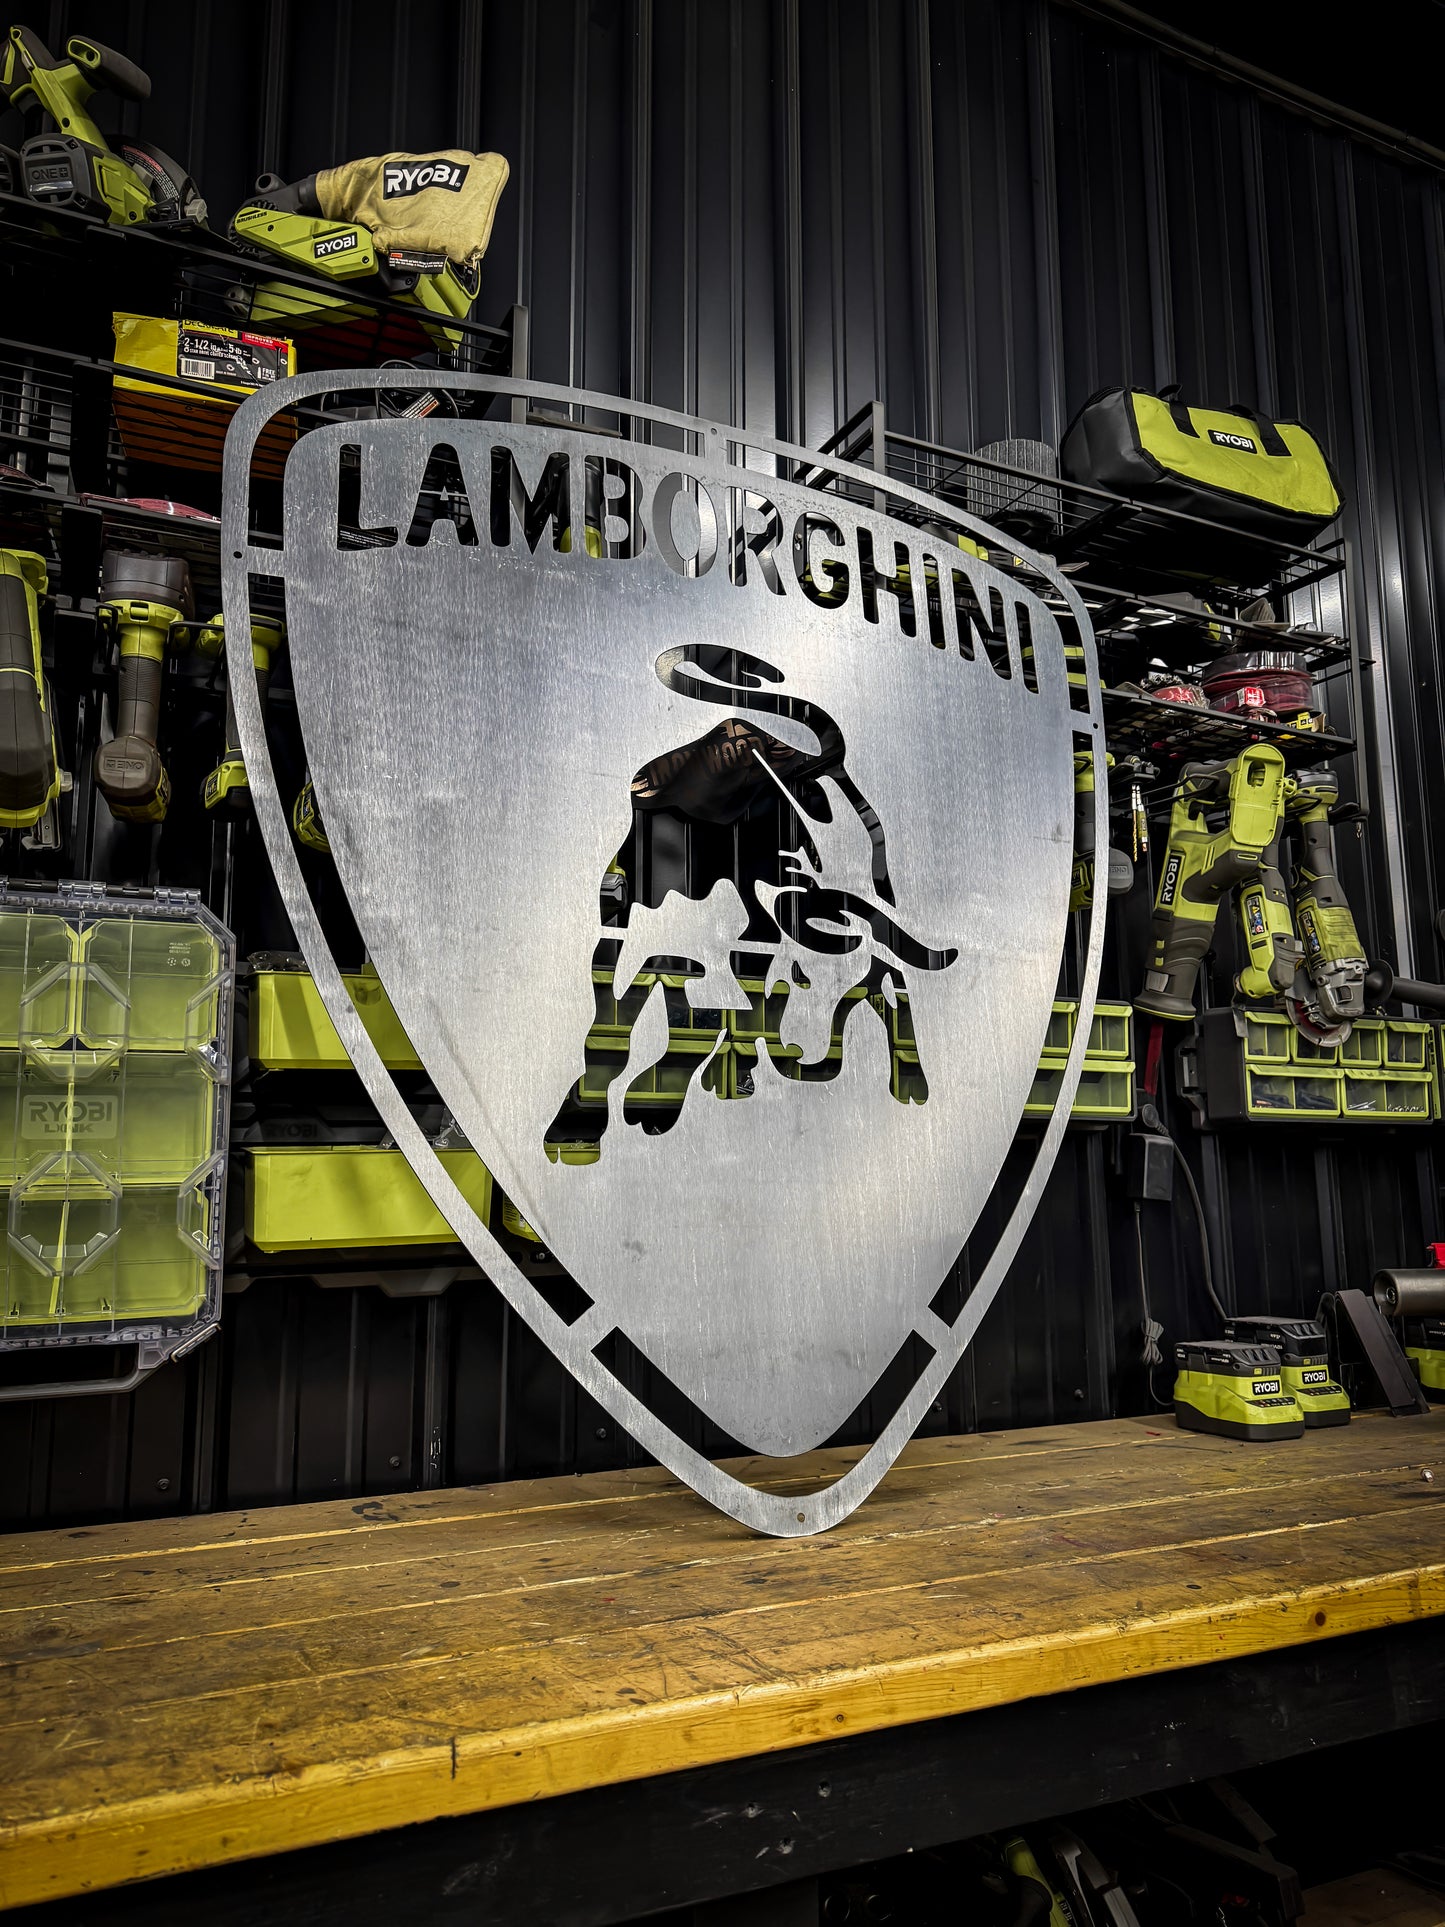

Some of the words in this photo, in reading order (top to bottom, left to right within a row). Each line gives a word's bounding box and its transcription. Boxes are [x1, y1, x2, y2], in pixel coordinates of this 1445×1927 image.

[386, 164, 461, 193] RYOBI
[237, 211, 268, 223] BRUSHLESS
[316, 235, 356, 256] RYOBI
[184, 337, 209, 351] 2-1/2
[1213, 431, 1254, 450] RYOBI
[336, 442, 1040, 695] LAMBORGHINI
[1162, 858, 1179, 902] RYOBI
[28, 1101, 113, 1122] RYOBI
[1303, 1371, 1326, 1383] RYOBI
[1254, 1381, 1278, 1394] RYOBI
